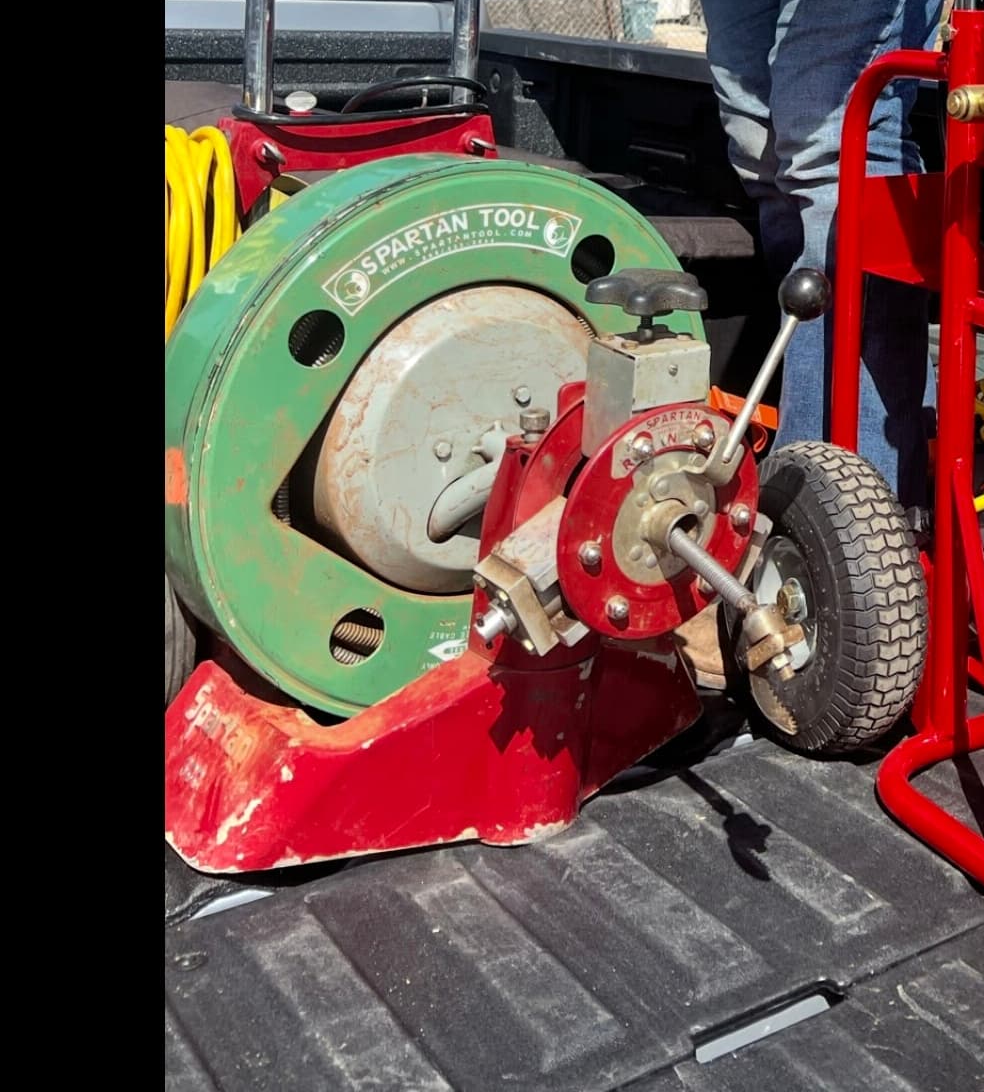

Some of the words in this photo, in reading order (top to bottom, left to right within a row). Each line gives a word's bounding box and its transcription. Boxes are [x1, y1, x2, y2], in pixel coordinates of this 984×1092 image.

[360, 211, 469, 275] SPARTAN
[479, 208, 540, 230] TOOL
[381, 229, 533, 275] WWW.SPARTANTOOL.COM
[646, 411, 701, 430] SPARTAN
